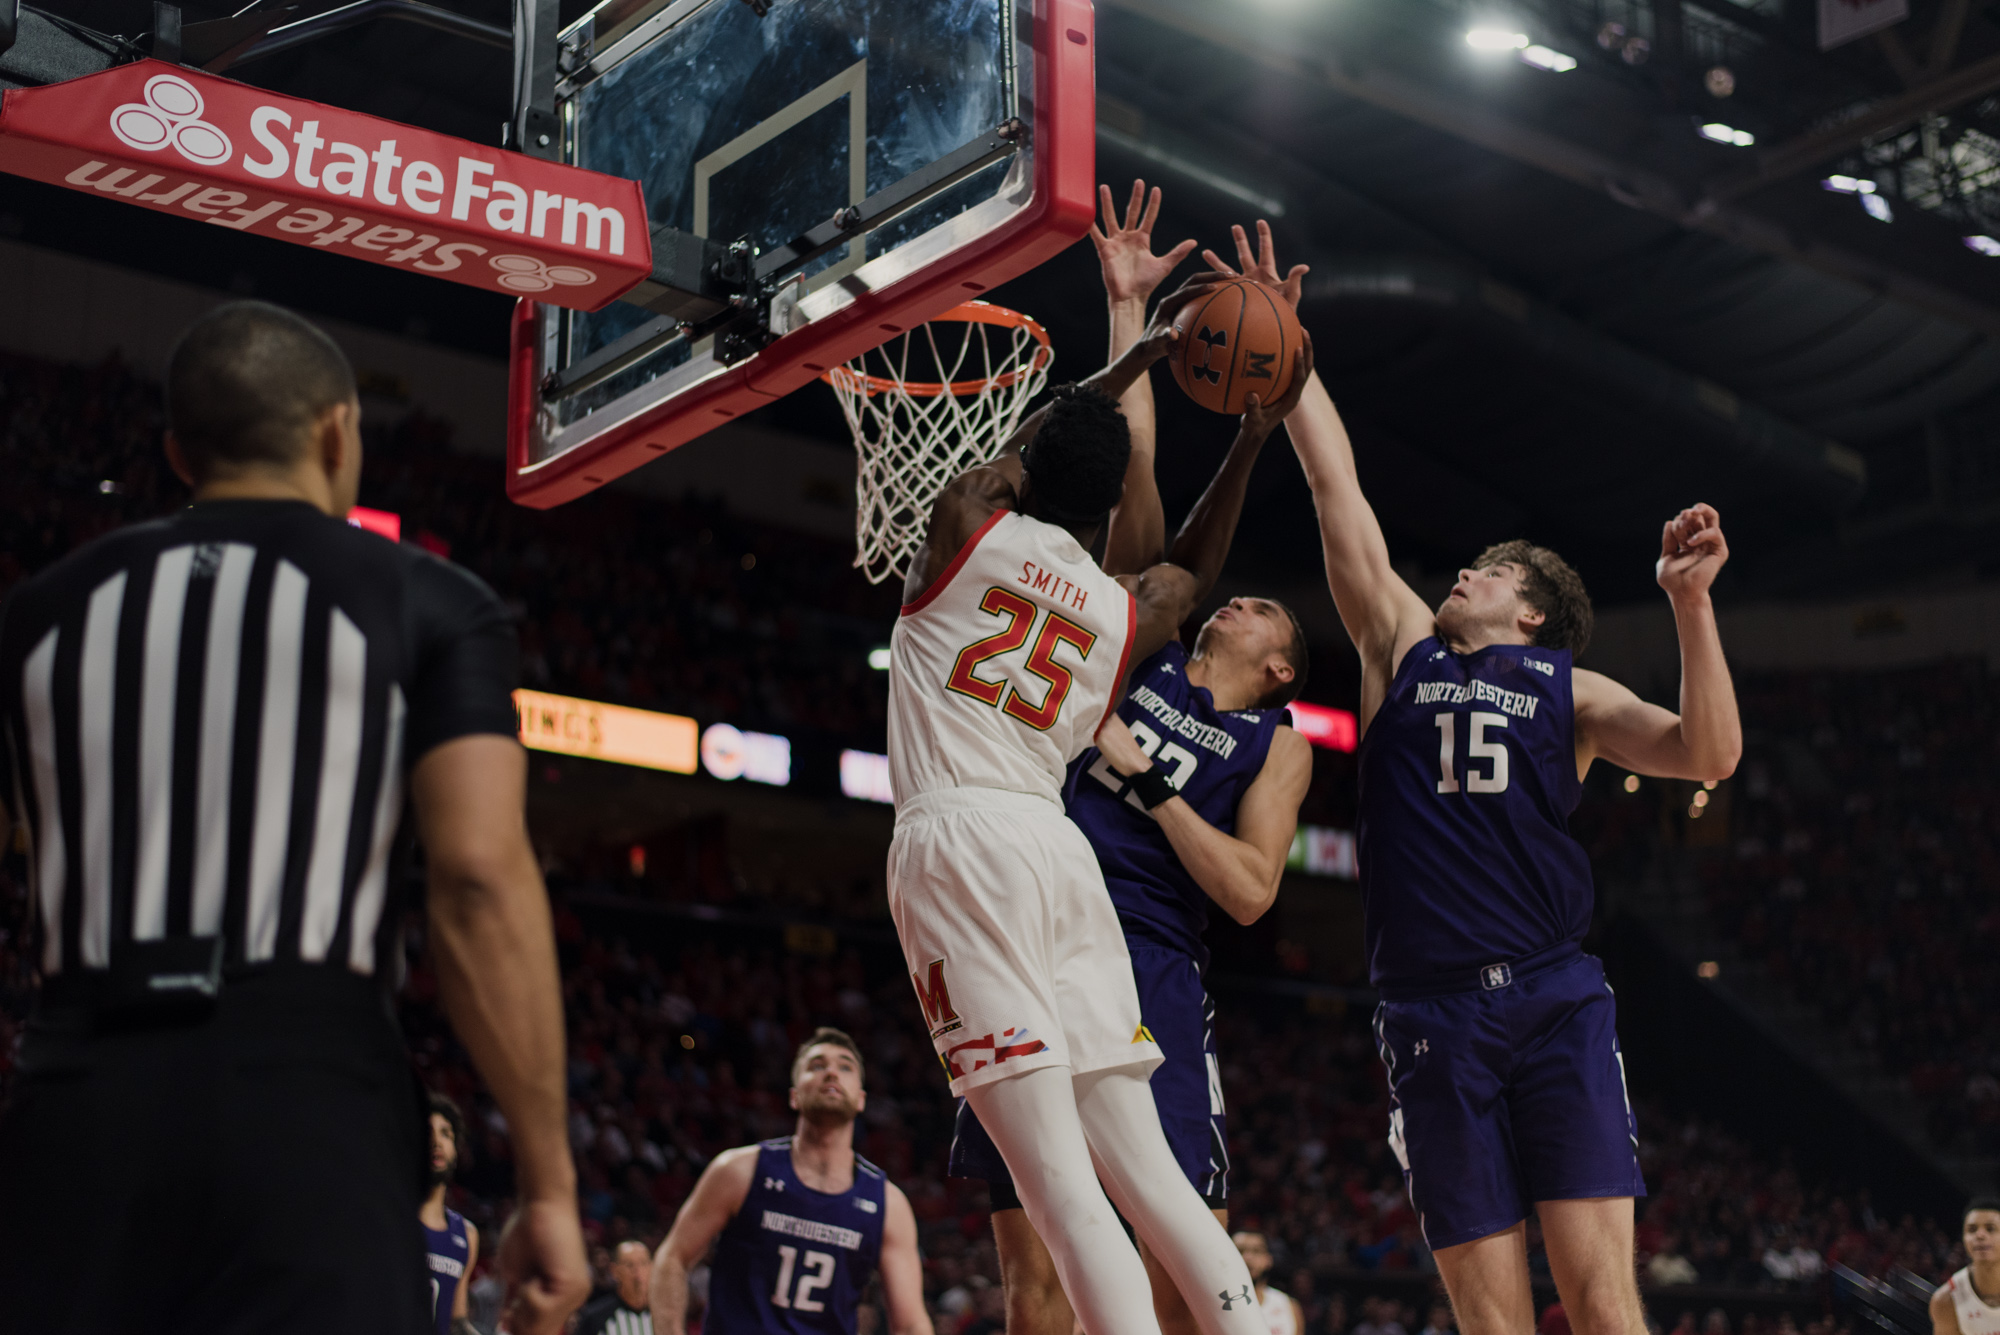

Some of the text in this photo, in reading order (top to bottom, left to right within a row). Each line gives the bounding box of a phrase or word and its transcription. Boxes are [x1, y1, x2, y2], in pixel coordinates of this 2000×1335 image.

[1245, 352, 1276, 381] M
[1018, 561, 1089, 611] SMITH
[945, 586, 1098, 731] 25
[1434, 711, 1509, 794] 15
[913, 959, 959, 1032] M
[771, 1244, 836, 1313] 12
